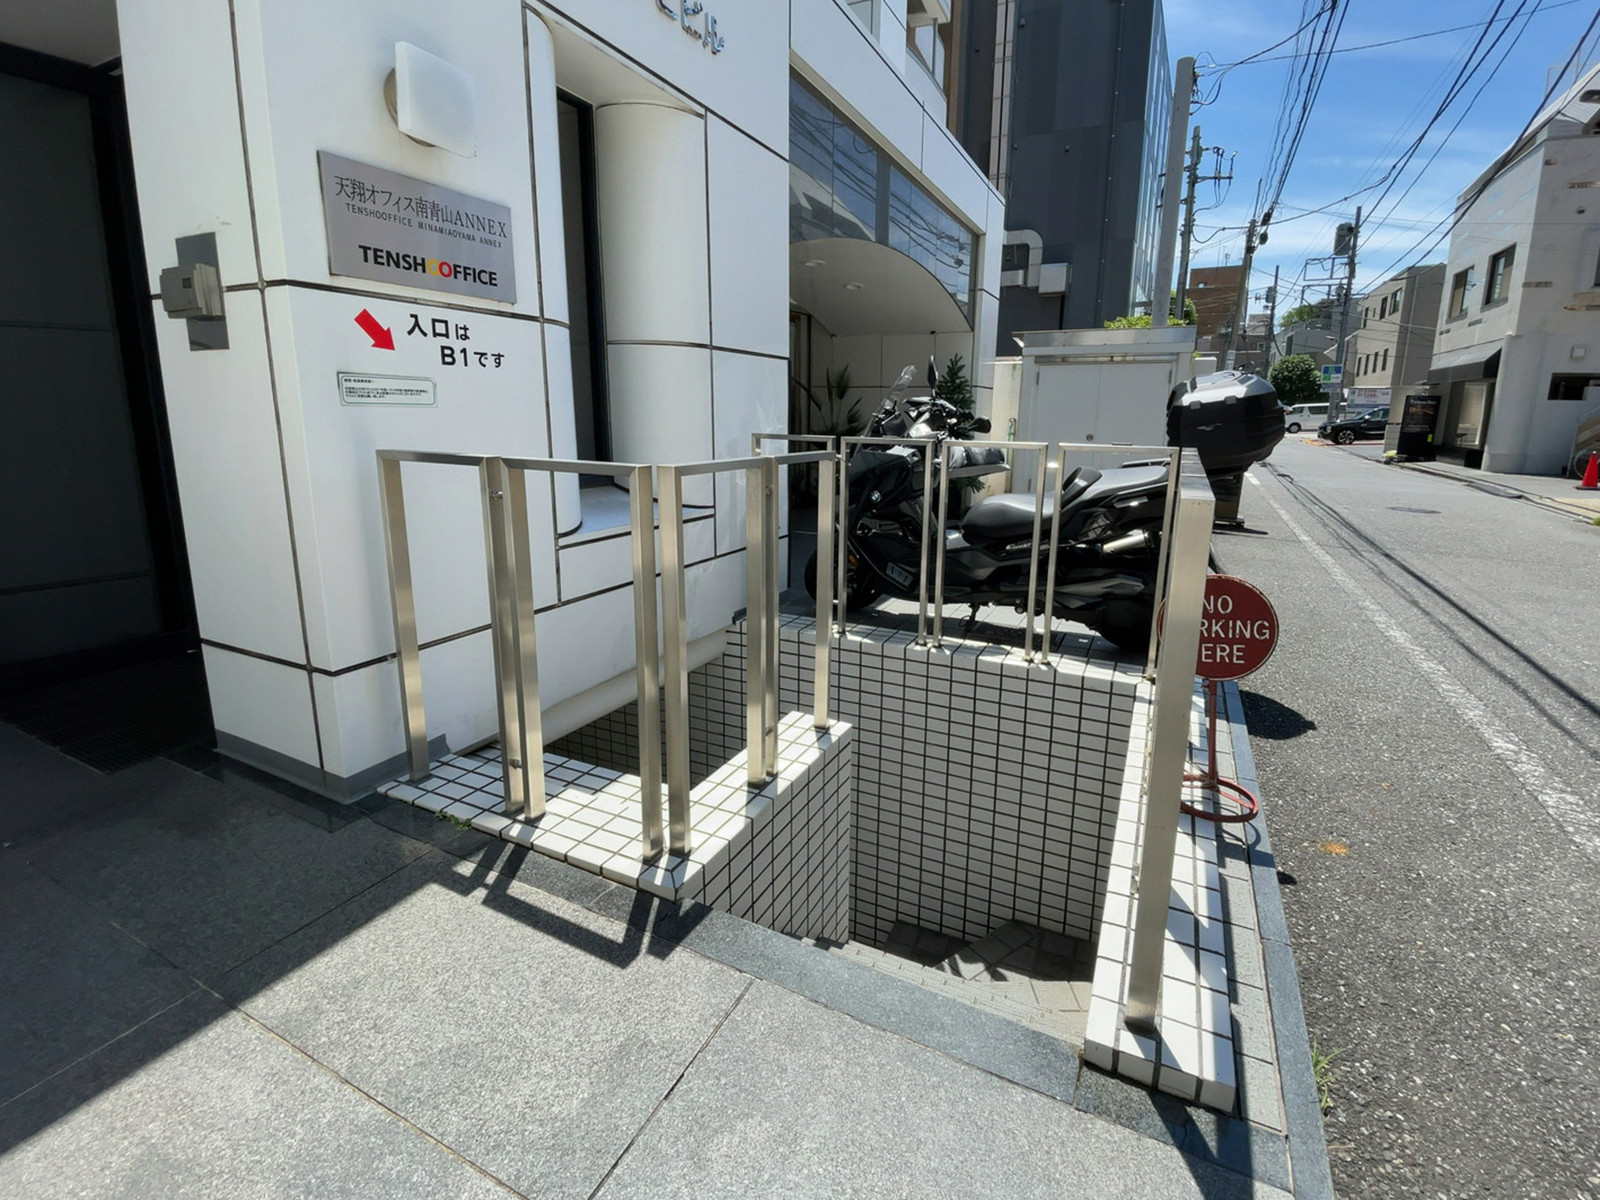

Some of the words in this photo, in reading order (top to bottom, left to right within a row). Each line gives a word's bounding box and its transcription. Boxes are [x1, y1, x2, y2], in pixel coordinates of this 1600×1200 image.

[334, 175, 508, 239] 天翔オフィス南青山ANNEX
[345, 202, 413, 228] TENSHOOFFICE
[418, 222, 476, 242] MINAMIAOYAMA
[479, 236, 502, 248] ANNEX
[358, 244, 498, 287] TENSHOOFFICE
[406, 314, 471, 341] 入口は
[440, 345, 505, 368] B1です
[1204, 595, 1233, 614] NO
[1200, 619, 1270, 640] RKING
[1201, 643, 1246, 664] ERE
